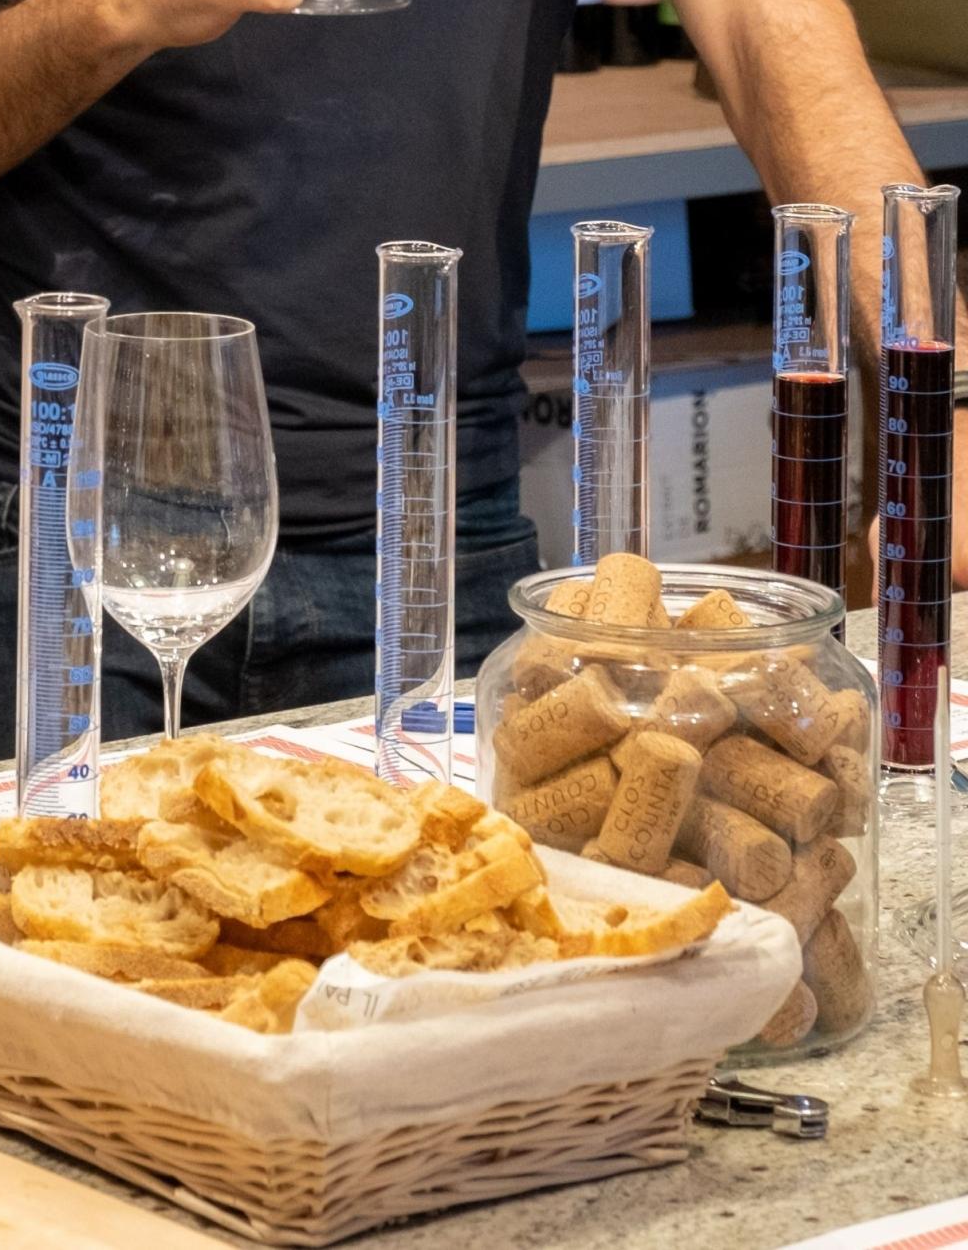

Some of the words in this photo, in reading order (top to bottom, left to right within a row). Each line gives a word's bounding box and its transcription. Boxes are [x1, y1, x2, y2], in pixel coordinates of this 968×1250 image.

[889, 375, 909, 391] 90
[888, 417, 908, 433] 80
[887, 459, 907, 475] 70
[887, 501, 906, 518] 60
[887, 542, 906, 559] 50
[68, 764, 89, 780] 40
[629, 764, 681, 862] COUNTA
